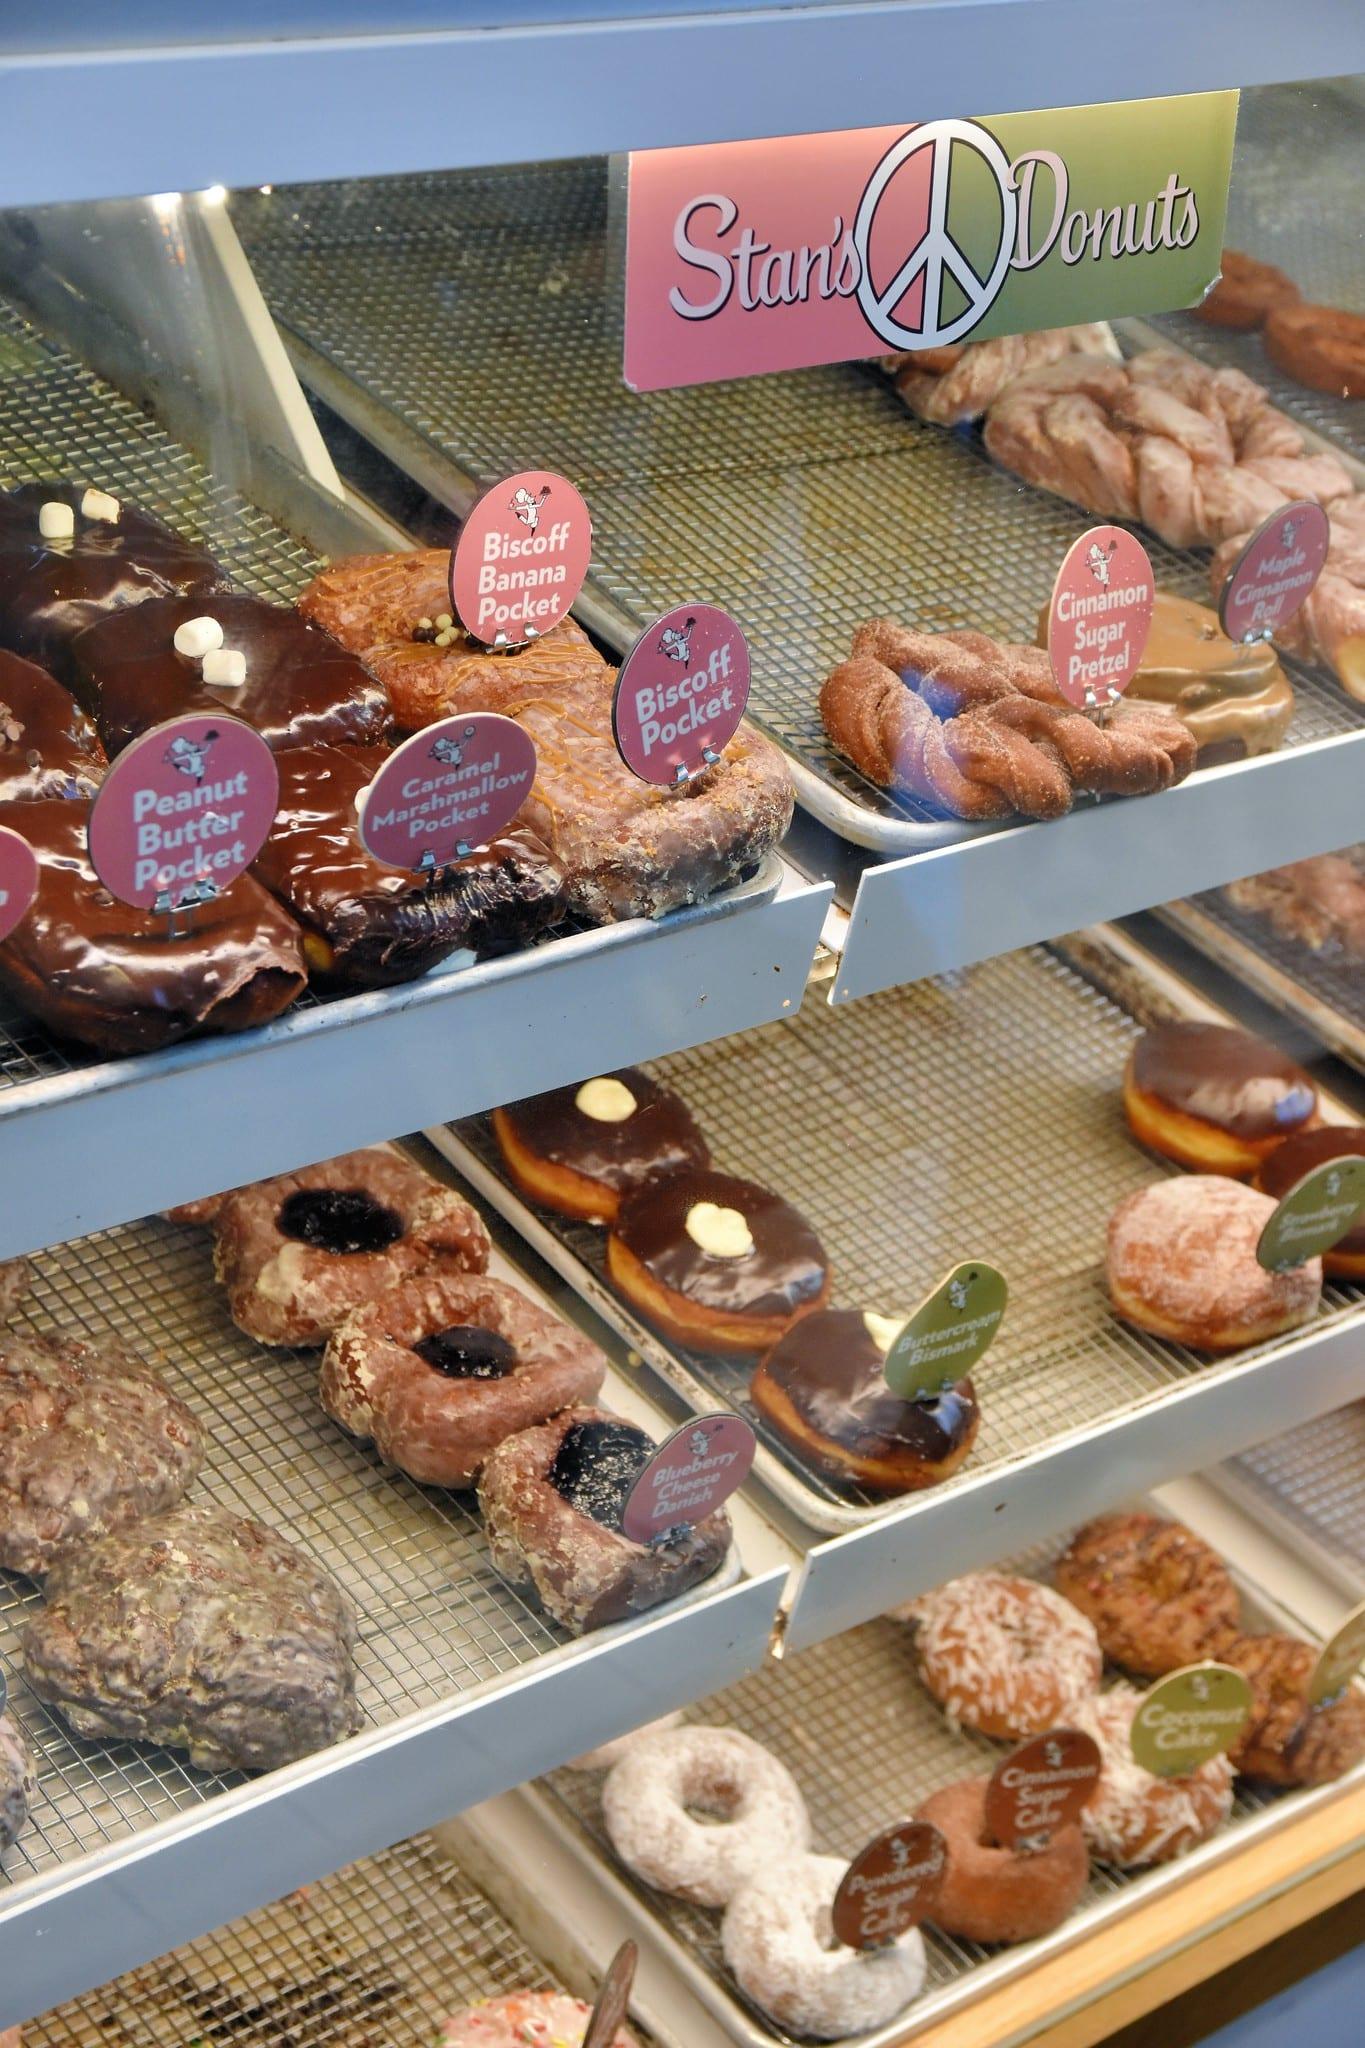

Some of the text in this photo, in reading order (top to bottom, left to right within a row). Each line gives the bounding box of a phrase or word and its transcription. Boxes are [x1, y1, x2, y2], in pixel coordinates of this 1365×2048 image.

[668, 150, 1200, 320] Stan's Donuts
[483, 521, 571, 562] Biscoff
[478, 564, 566, 595] Banana
[1234, 570, 1313, 606] Cinnamon
[477, 591, 560, 625] Pocket
[1056, 584, 1148, 622] Cinnamon
[1074, 620, 1126, 652] Sugar
[1068, 641, 1131, 684] Pretzel
[635, 643, 731, 724] Biscoff
[640, 688, 733, 756] Pocket
[401, 752, 500, 799] Caramel
[133, 770, 248, 823] Peanut
[372, 769, 528, 832] Marshmallow
[137, 810, 245, 856] Butter
[408, 801, 490, 839] Pocket
[134, 840, 246, 891] Pocket
[897, 1310, 1001, 1354] Buttercream
[908, 1330, 978, 1367] Bismark
[652, 1450, 739, 1488] Blueberry
[657, 1471, 721, 1500] Cheese
[652, 1486, 713, 1518] Danish
[1155, 1726, 1218, 1750] Cake
